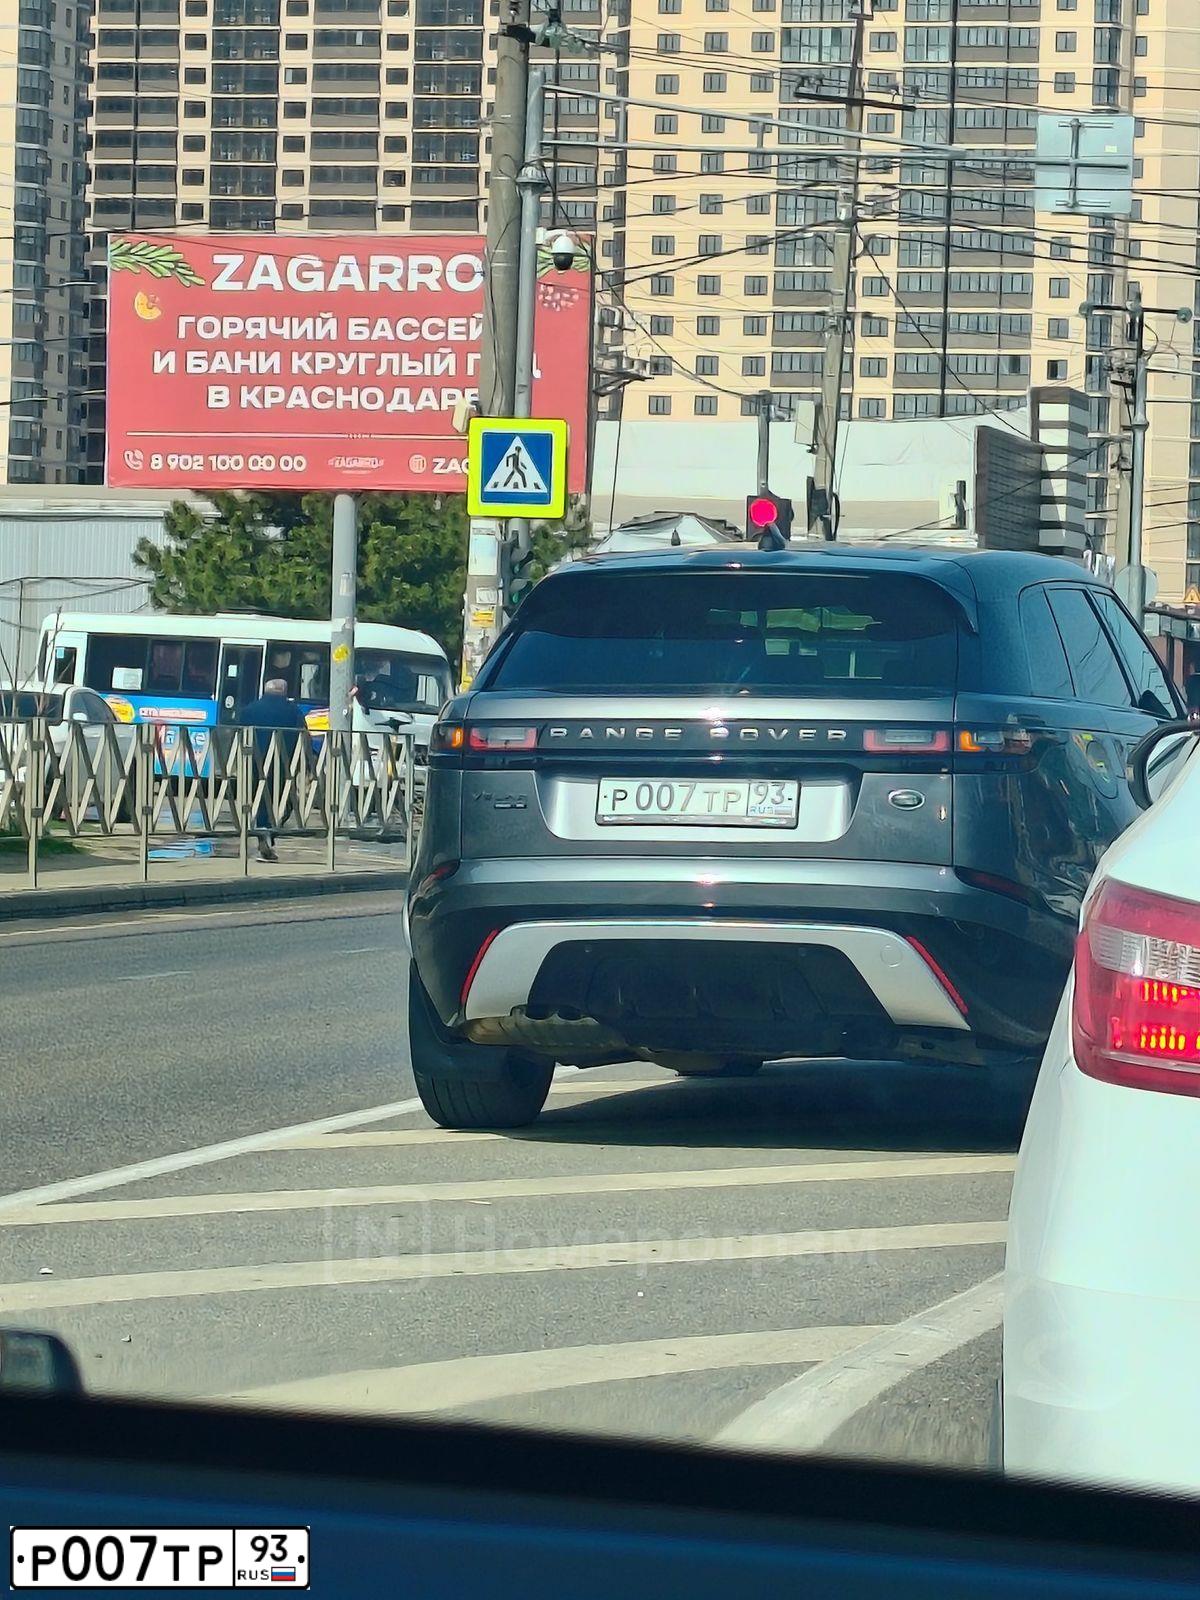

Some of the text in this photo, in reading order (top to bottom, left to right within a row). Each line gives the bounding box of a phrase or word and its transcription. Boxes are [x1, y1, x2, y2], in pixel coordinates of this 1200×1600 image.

[212, 253, 484, 293] ZAGARRO
[178, 312, 484, 341] ГОРЯЧИЙ БАССЕЙ
[153, 351, 176, 374] И
[186, 351, 281, 374] БАНИ
[291, 347, 457, 376] КРУГЛЫЙ
[207, 385, 231, 409] В
[150, 453, 307, 472] 8 902 100 00 00
[550, 727, 848, 741] RANGE ROVER
[754, 782, 785, 805] 93
